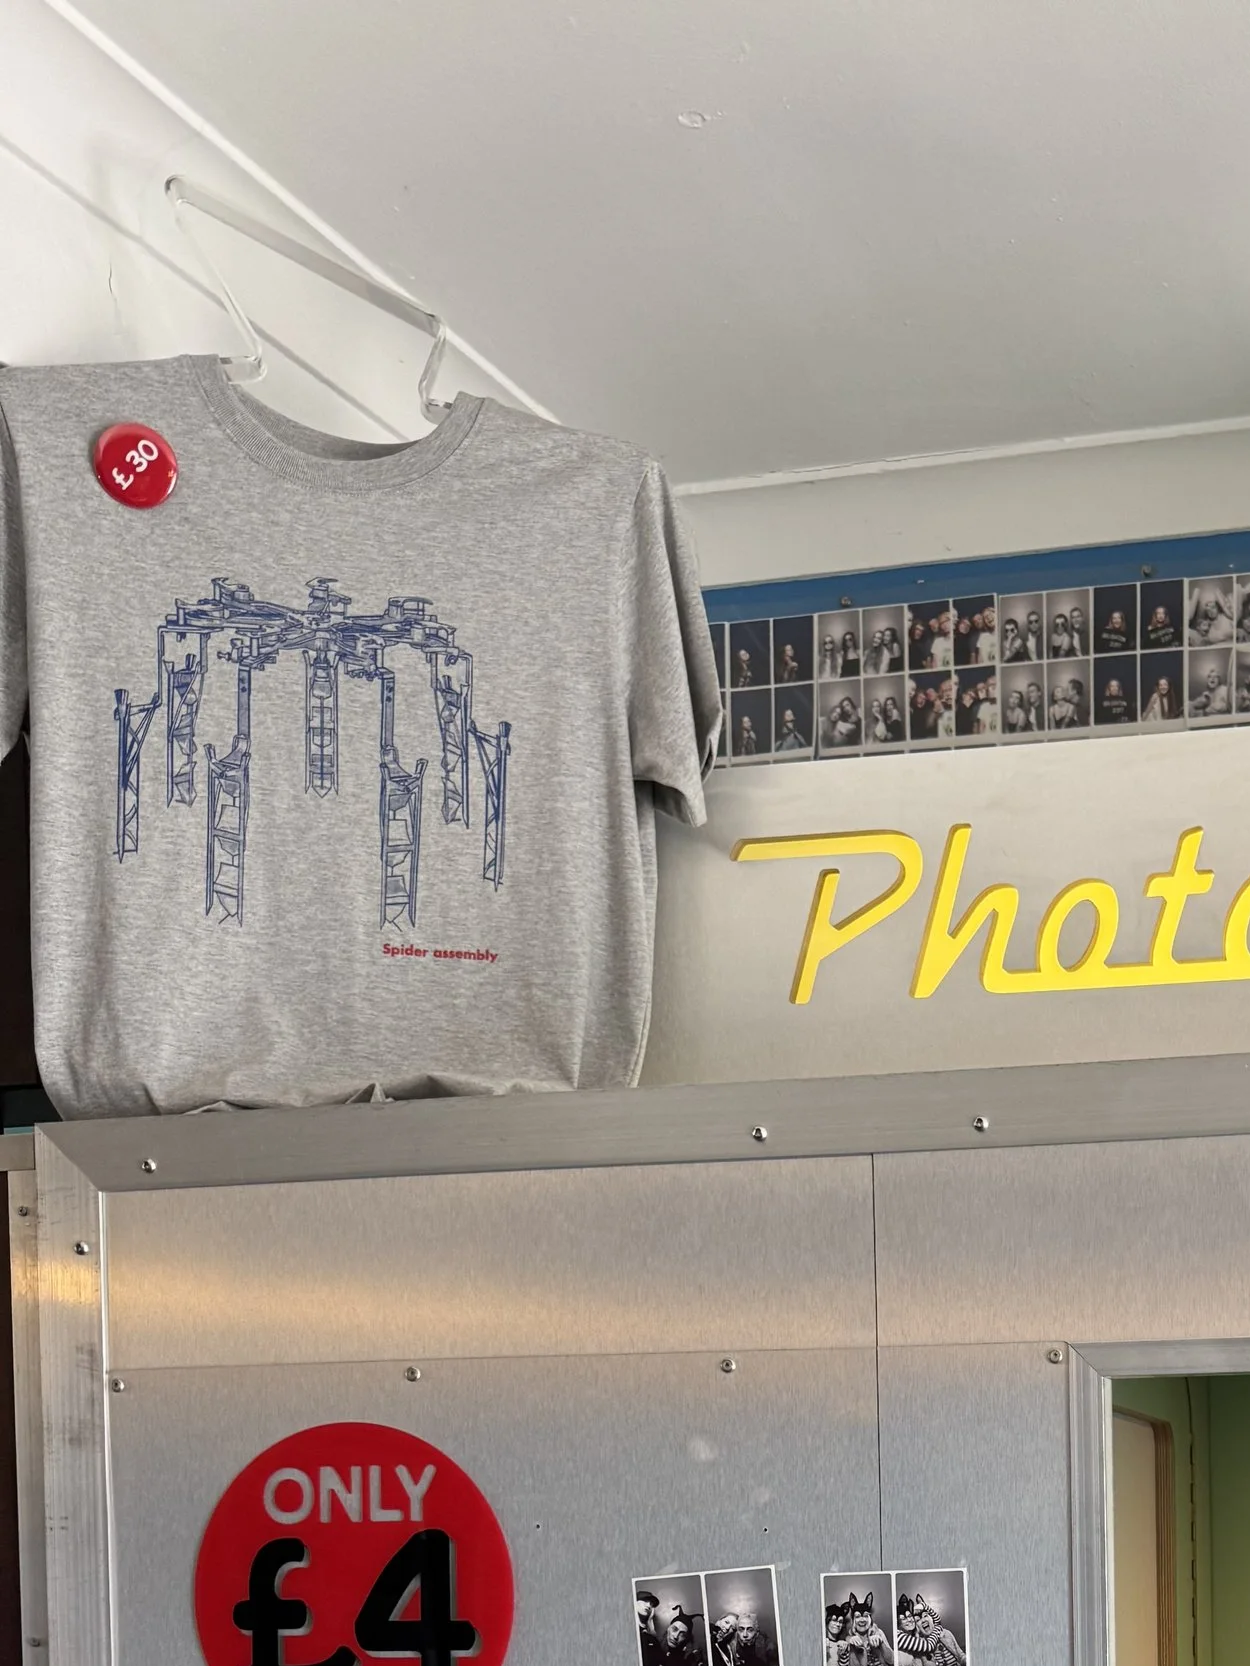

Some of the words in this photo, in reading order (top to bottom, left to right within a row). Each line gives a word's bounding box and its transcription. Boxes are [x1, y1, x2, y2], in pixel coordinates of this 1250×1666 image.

[383, 943, 428, 957] Spider
[433, 949, 498, 963] assembly
[263, 1464, 437, 1525] ONLY
